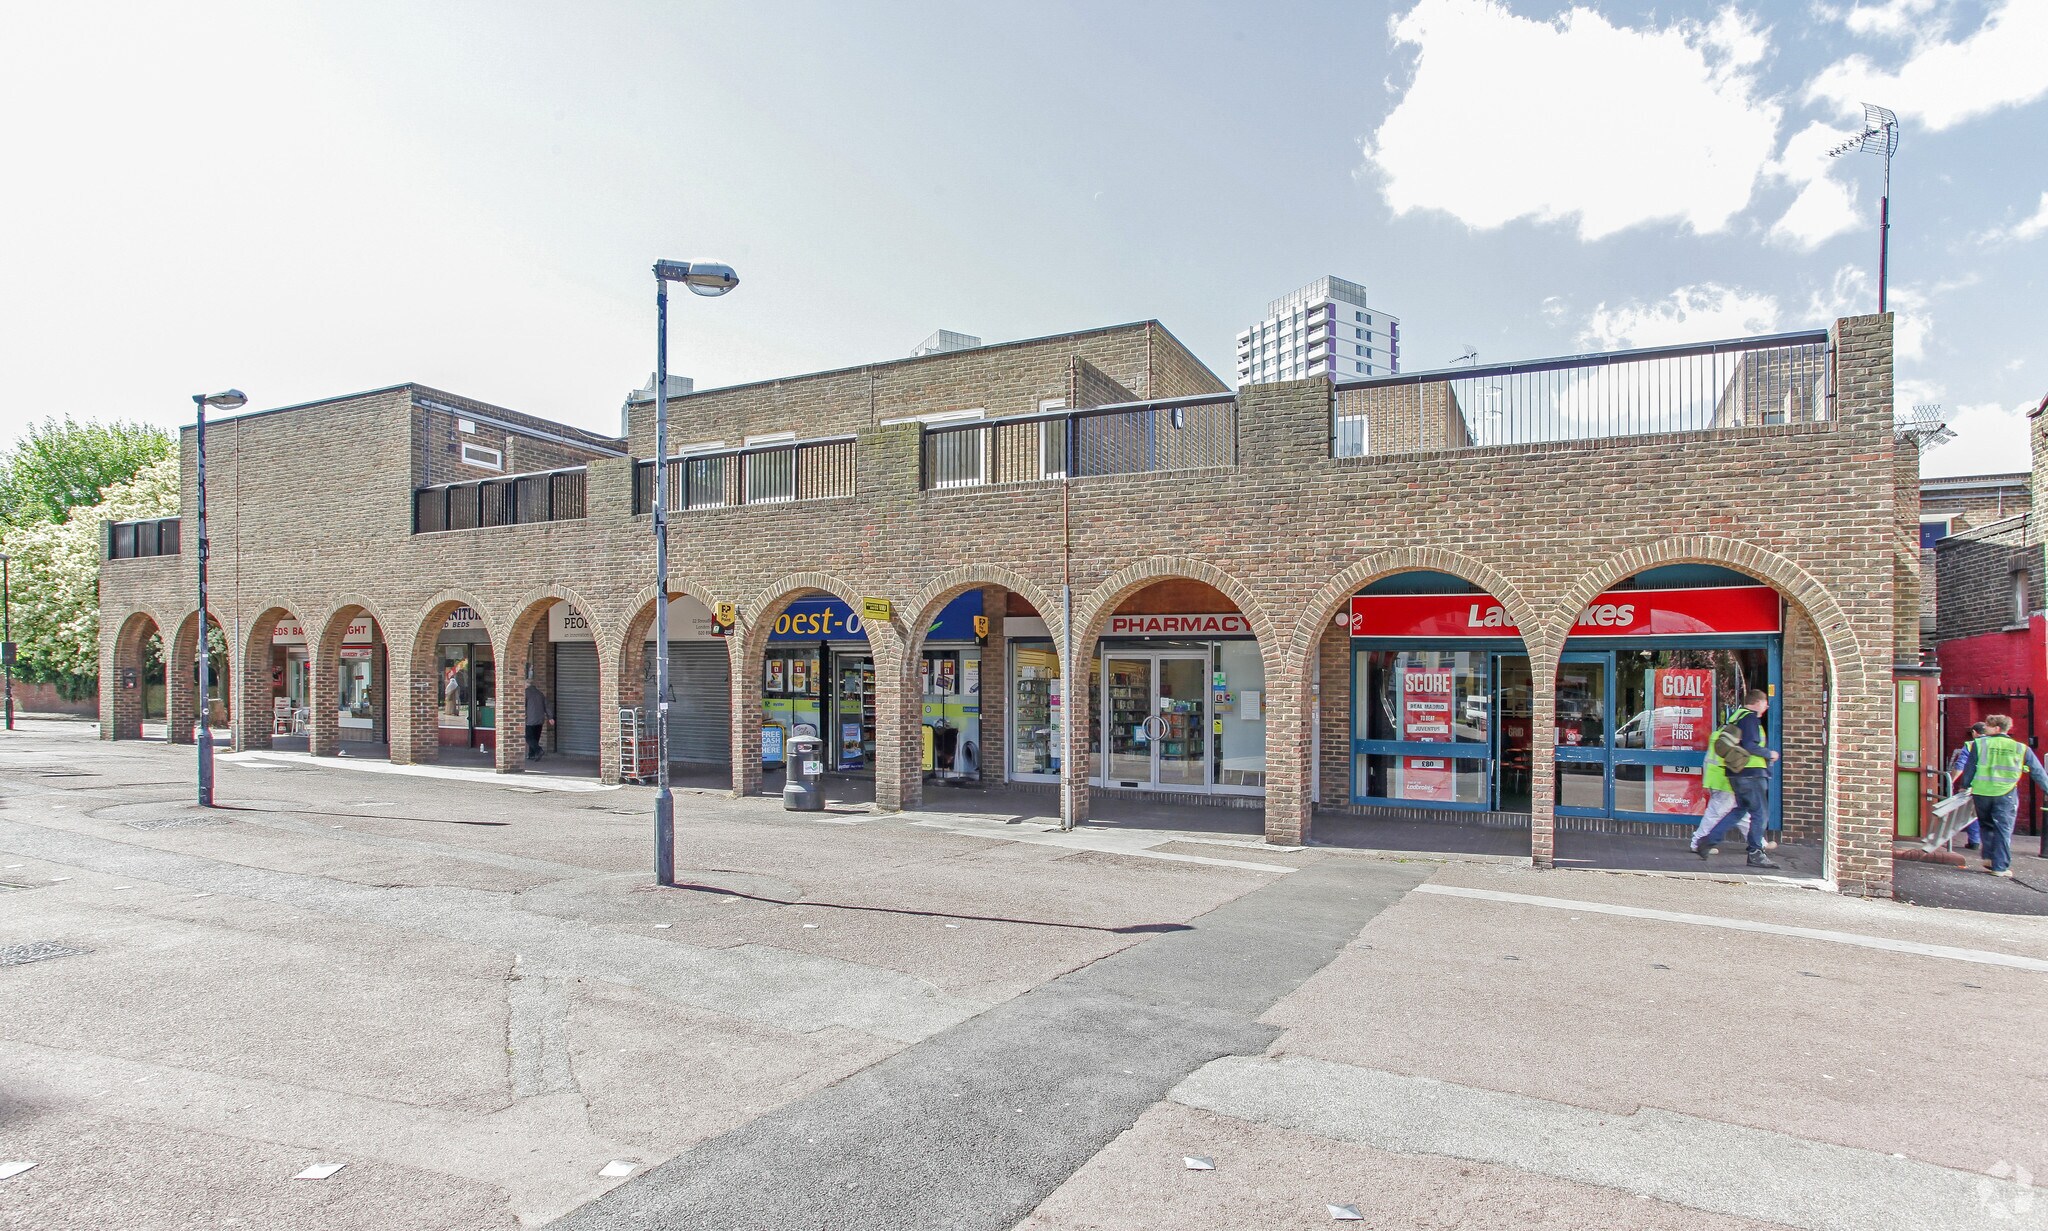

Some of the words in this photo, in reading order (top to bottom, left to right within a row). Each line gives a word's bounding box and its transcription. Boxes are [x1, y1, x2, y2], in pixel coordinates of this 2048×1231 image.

[1405, 673, 1450, 693] SCORE
[1662, 675, 1705, 697] GOAL
[761, 730, 781, 738] FREE
[1671, 729, 1694, 740] FIRST
[761, 746, 781, 754] HERE
